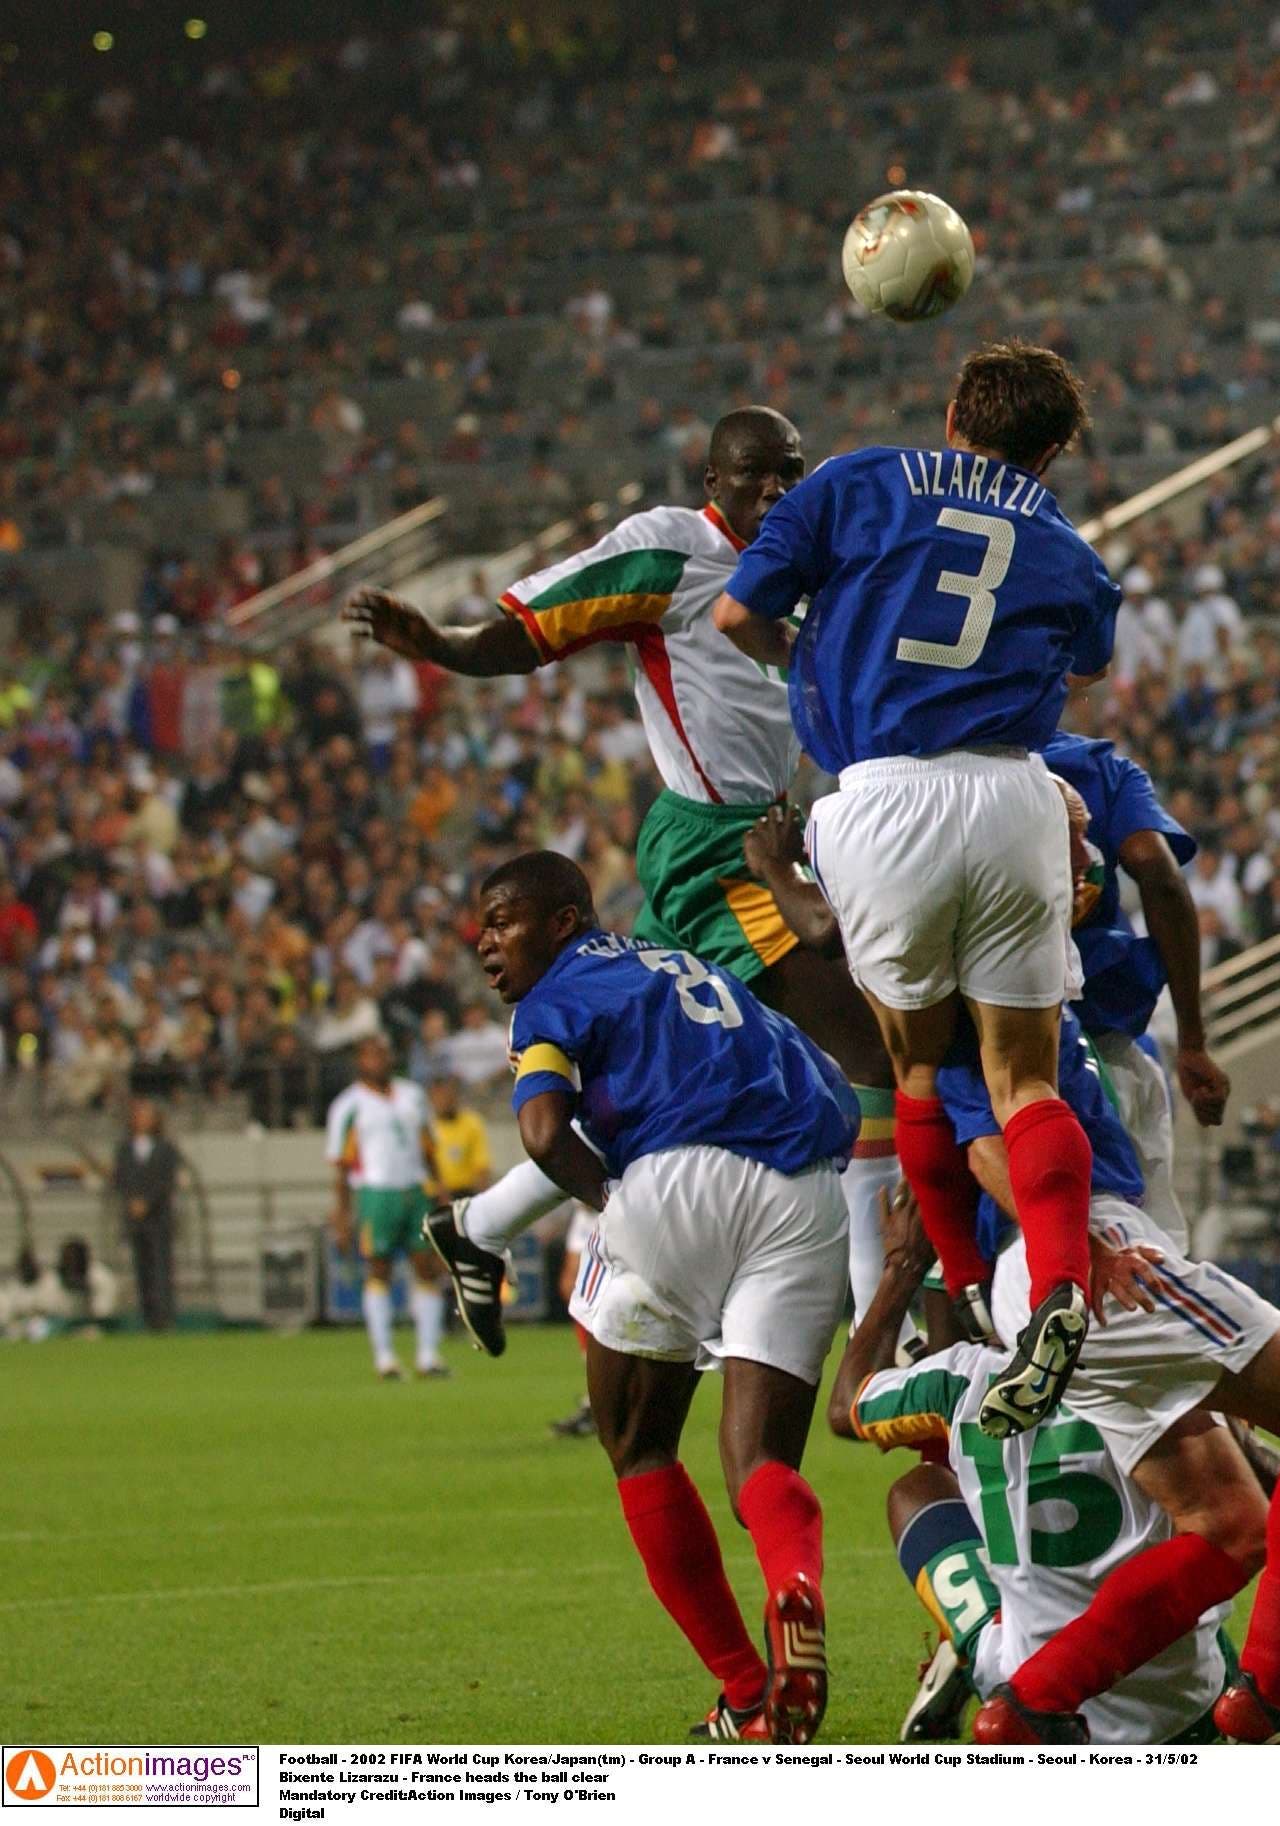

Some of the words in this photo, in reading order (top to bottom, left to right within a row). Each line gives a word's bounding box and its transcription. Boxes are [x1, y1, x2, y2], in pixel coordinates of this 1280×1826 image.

[900, 451, 1047, 518] LIZARAZU
[895, 507, 1015, 669] 3
[638, 949, 744, 1029] 8
[959, 1419, 1123, 1568] 15
